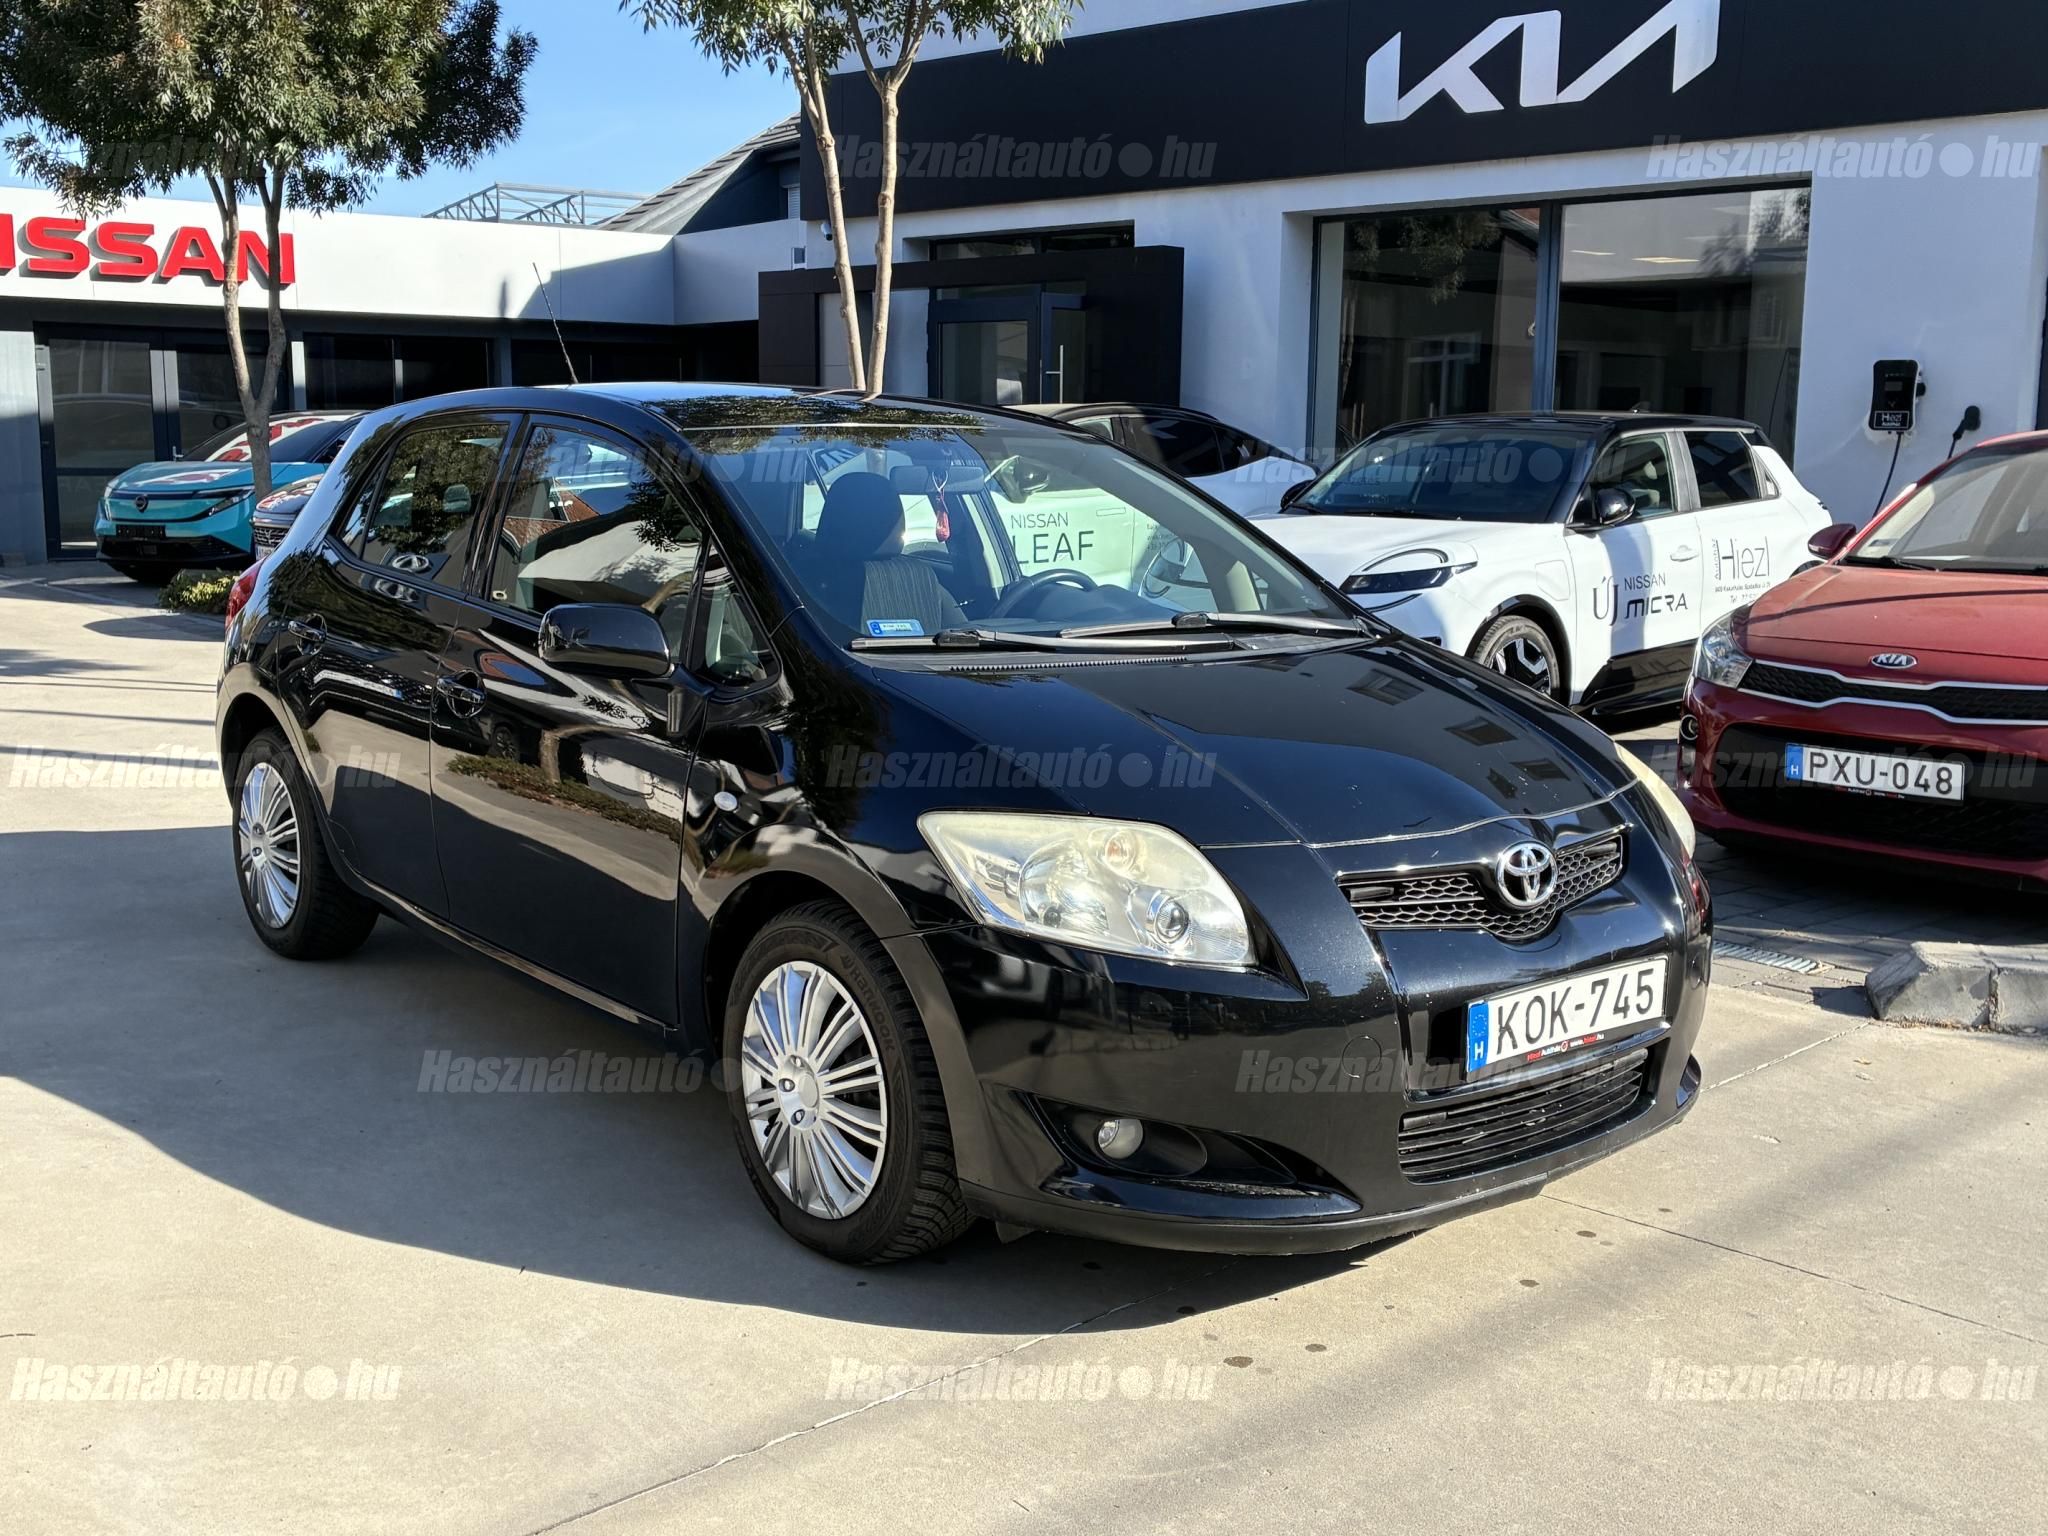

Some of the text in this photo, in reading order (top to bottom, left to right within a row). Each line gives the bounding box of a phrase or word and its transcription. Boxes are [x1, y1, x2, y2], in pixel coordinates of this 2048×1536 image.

[1364, 0, 1721, 124] KIA
[1010, 511, 1069, 529] NISSAN
[1012, 530, 1094, 565] LEAF
[1716, 535, 1770, 580] Hiezl
[1624, 572, 1667, 591] NISSAN
[1876, 652, 1908, 666] KIA
[1790, 764, 1799, 776] H
[1809, 751, 1953, 795] PXU-048
[1474, 968, 1654, 1062] H KOK-745
